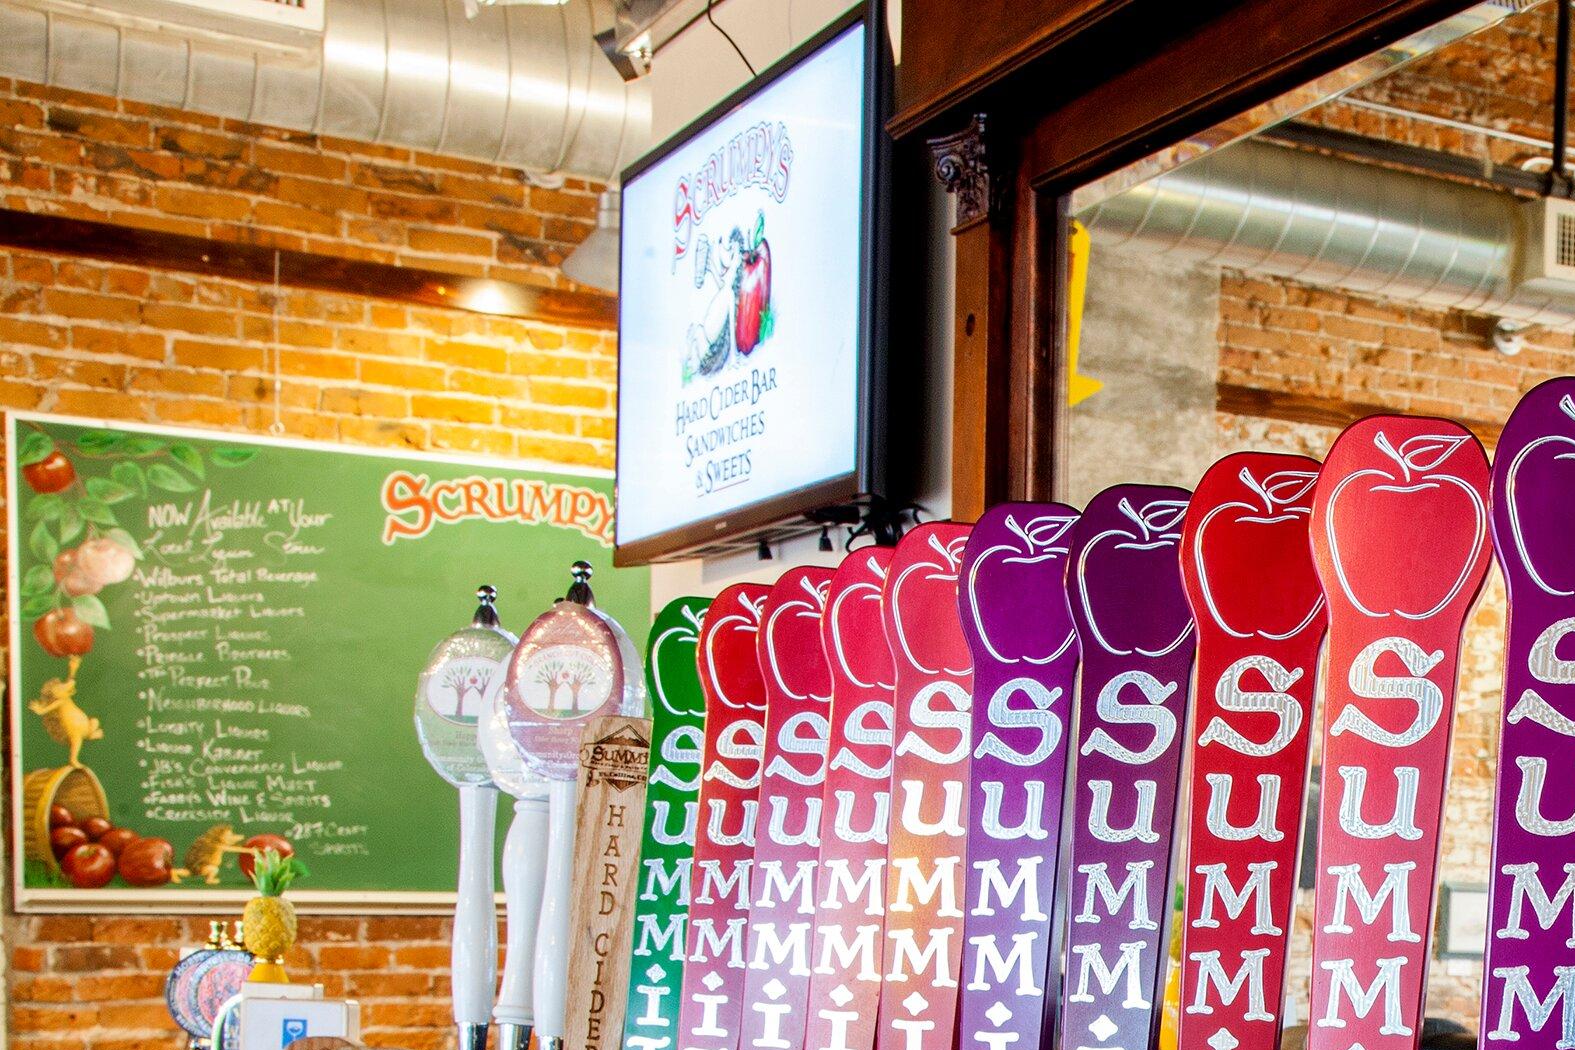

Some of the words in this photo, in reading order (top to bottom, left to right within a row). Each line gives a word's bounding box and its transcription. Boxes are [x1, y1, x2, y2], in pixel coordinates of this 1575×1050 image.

[674, 397, 708, 437] HARD
[708, 381, 750, 423] CIDER
[750, 366, 778, 406] BAR
[685, 410, 765, 467] SANDWICHES
[704, 458, 752, 494] SWEETS
[148, 501, 193, 528] NOW
[591, 746, 648, 764] SUMMI
[599, 804, 626, 916] HARD
